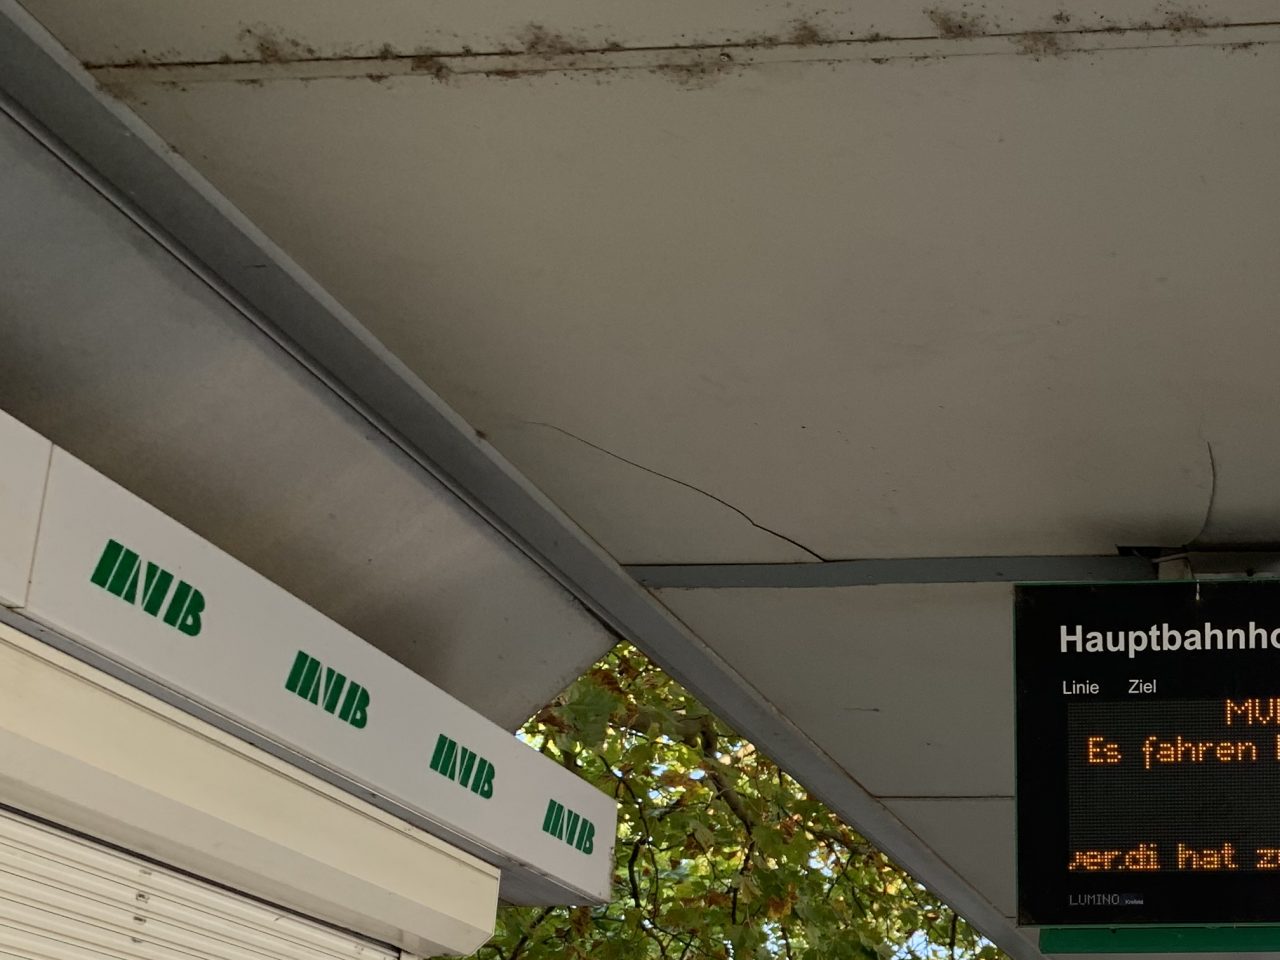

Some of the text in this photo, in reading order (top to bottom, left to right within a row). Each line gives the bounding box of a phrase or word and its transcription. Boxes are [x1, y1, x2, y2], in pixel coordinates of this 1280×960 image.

[1062, 680, 1100, 695] Linie
[1128, 679, 1157, 694] Ziel
[1088, 736, 1123, 763] Es
[1142, 735, 1257, 770] fahren
[1177, 842, 1239, 869] hat
[1069, 893, 1121, 906] LUMINO
